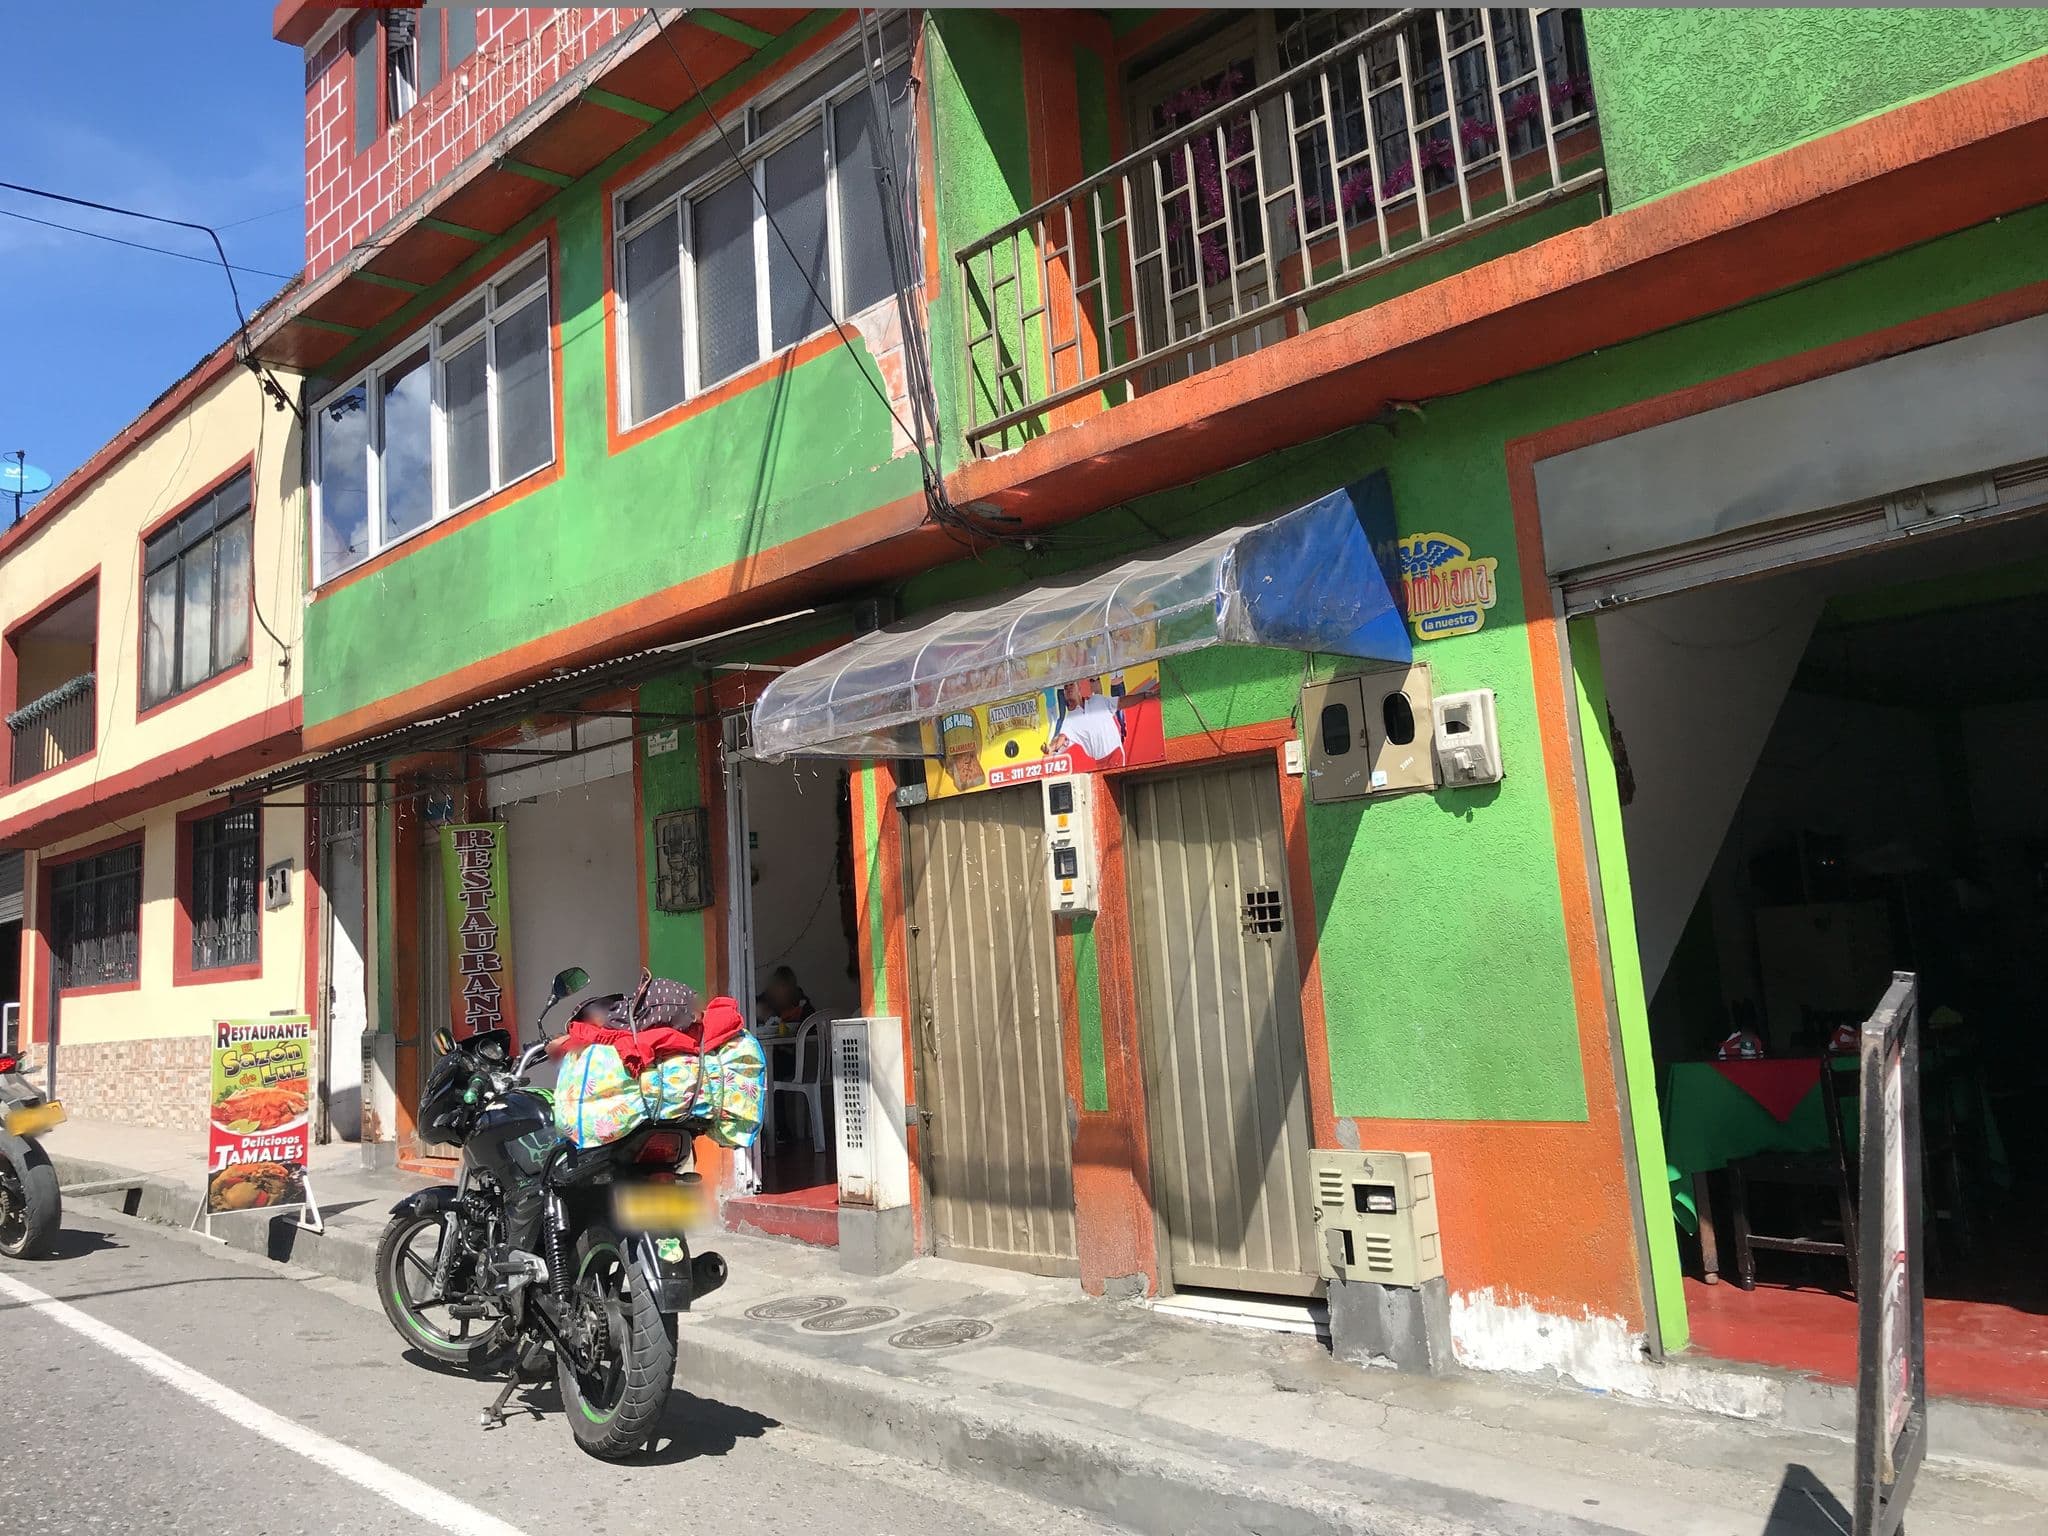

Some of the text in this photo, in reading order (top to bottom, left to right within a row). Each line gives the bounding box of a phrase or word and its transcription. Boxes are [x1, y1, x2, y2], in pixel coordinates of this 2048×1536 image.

[1424, 615, 1475, 631] la nuestra
[943, 715, 954, 732] LOS
[1011, 768, 1024, 779] 311
[1025, 765, 1042, 777] 232
[1044, 760, 1067, 773] 1742
[217, 1022, 308, 1049] RESTAURANTE
[221, 1040, 303, 1078] Sazón
[239, 1062, 306, 1086] de Luz
[241, 1135, 300, 1149] Deliciosos
[215, 1143, 304, 1172] TAMALES
